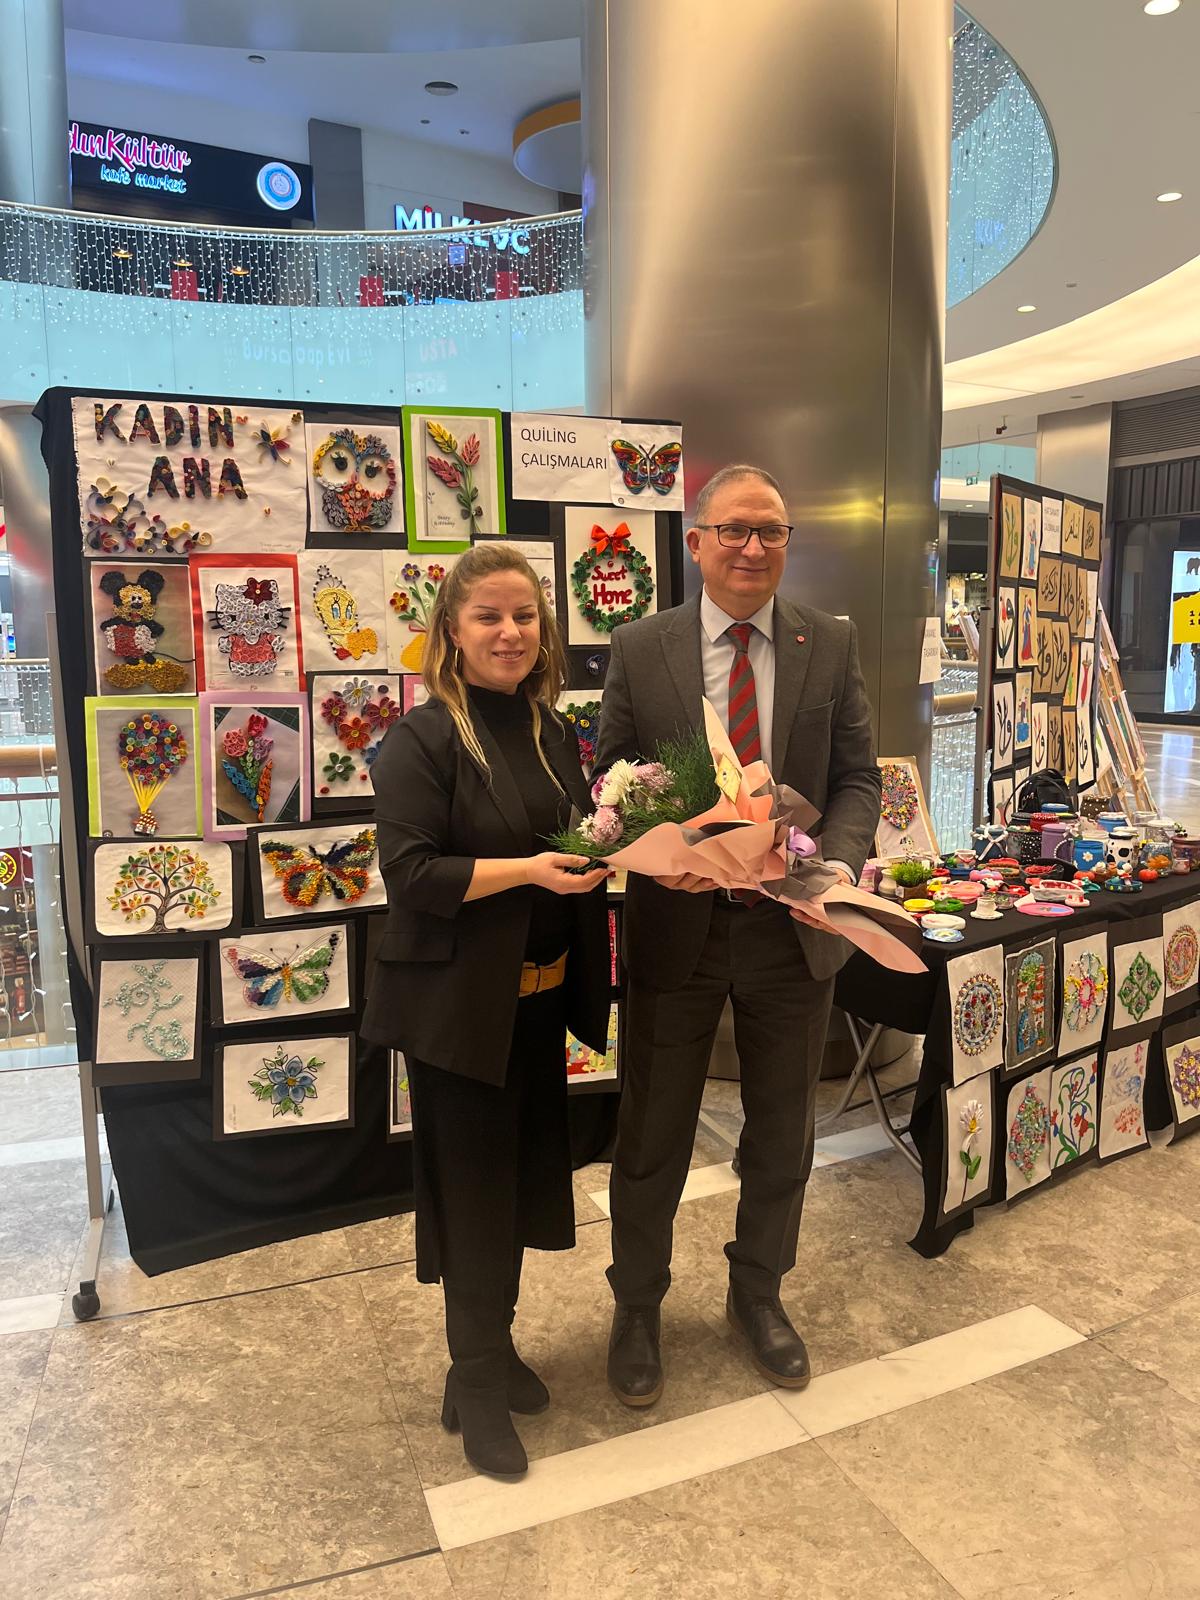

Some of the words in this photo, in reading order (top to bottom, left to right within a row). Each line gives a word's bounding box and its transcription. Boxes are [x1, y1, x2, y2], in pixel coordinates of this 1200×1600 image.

[101, 164, 131, 185] kafe
[135, 172, 187, 193] market
[94, 403, 235, 448] KADIN
[520, 426, 577, 444] QUİLİNG
[521, 452, 607, 470] ÇALIŞMALARI
[147, 455, 249, 500] ANA
[591, 565, 628, 582] Sweet
[593, 583, 633, 606] Home
